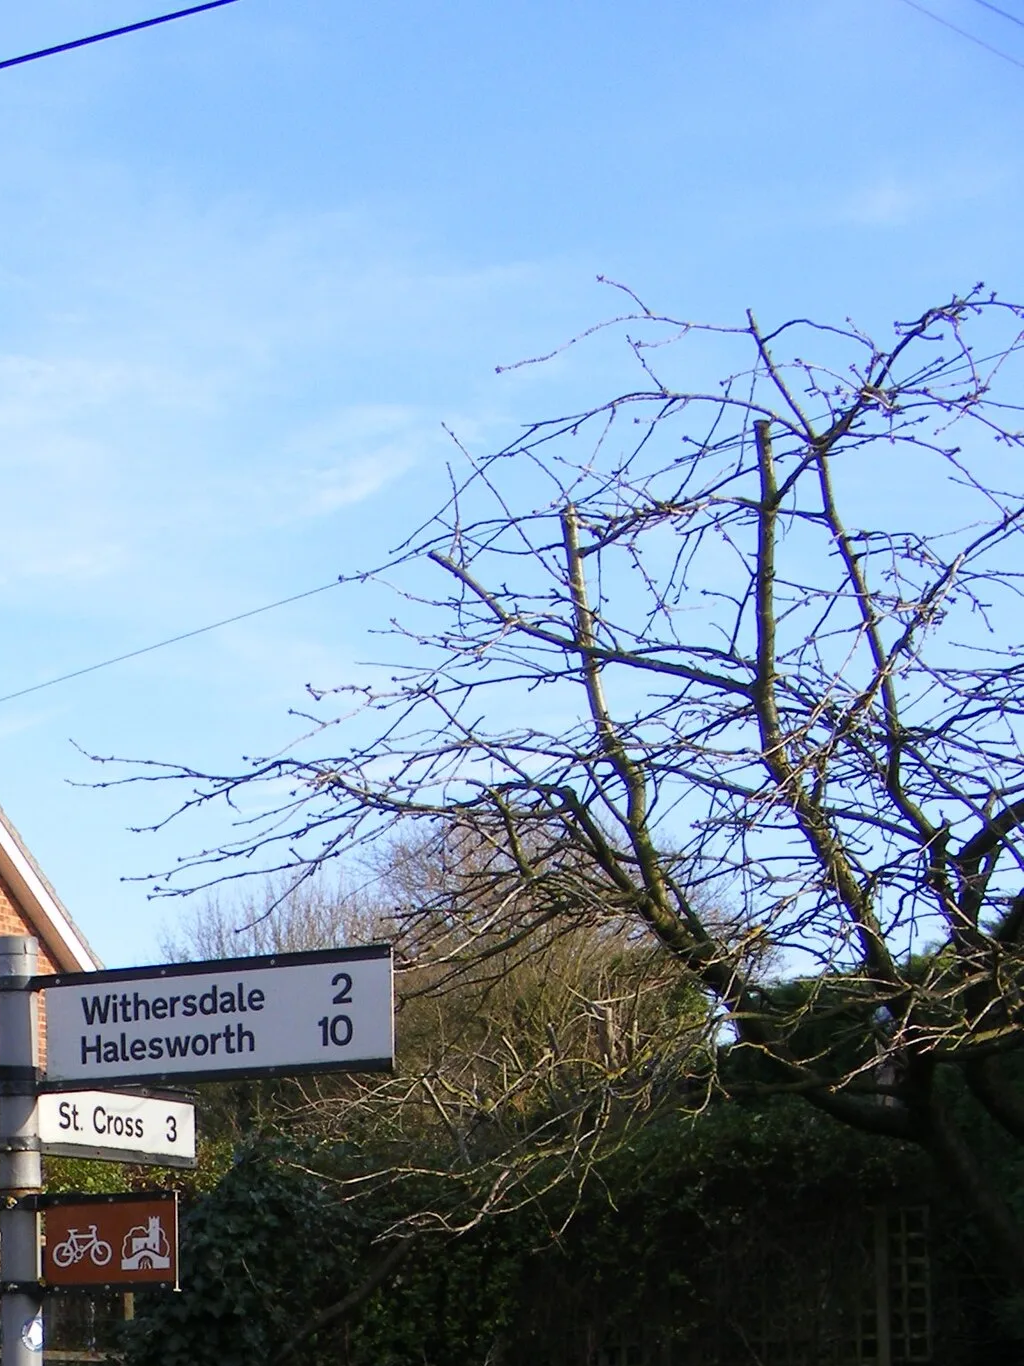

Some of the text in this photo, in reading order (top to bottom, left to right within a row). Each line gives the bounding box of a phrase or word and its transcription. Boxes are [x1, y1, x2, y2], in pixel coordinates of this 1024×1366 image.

[81, 972, 354, 1026] Withersdale 2
[80, 1014, 354, 1065] Halesworth 10
[58, 1101, 178, 1143] St. Cross 3
